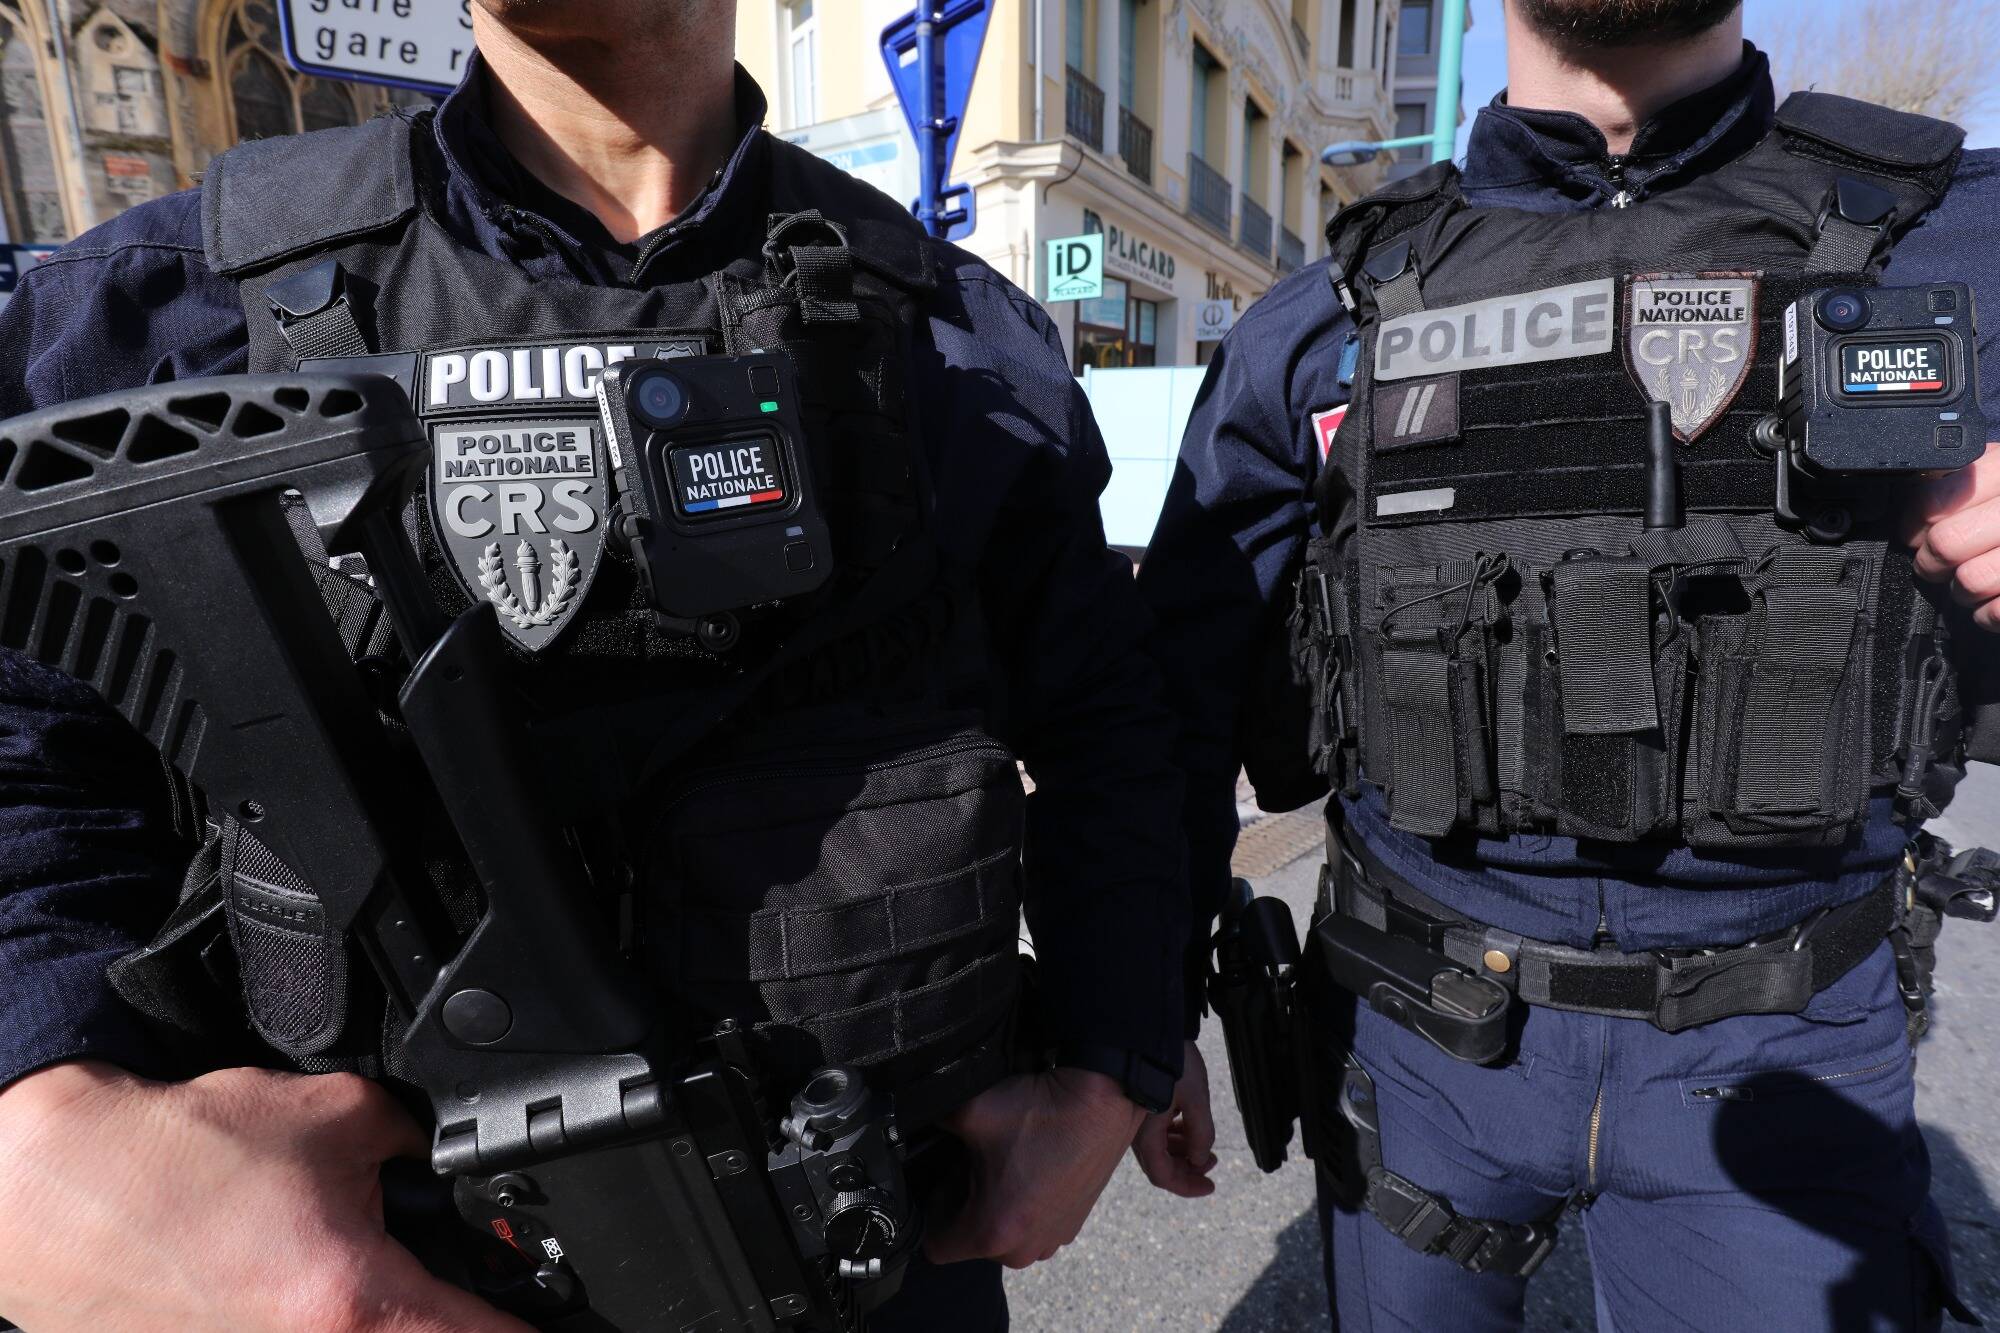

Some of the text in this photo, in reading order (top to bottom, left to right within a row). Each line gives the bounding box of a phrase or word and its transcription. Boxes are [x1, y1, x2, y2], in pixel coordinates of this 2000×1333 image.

[316, 26, 418, 64] gare
[1056, 243, 1092, 276] iD
[1109, 225, 1175, 280] PLACARD
[1054, 286, 1095, 297] PLACARD
[1652, 290, 1732, 307] POLICE
[1639, 306, 1745, 323] NATIONALE
[1379, 292, 1609, 371] POLICE
[1638, 328, 1742, 366] CRS
[1857, 347, 1929, 370] POLICE
[430, 345, 636, 406] POLIC
[1850, 369, 1937, 383] NATIONALE
[457, 431, 577, 456] POLICE
[445, 454, 592, 478] NATIONALE
[688, 446, 766, 482] POLICE
[686, 474, 776, 501] NATIONALE
[445, 479, 596, 538] CRS
